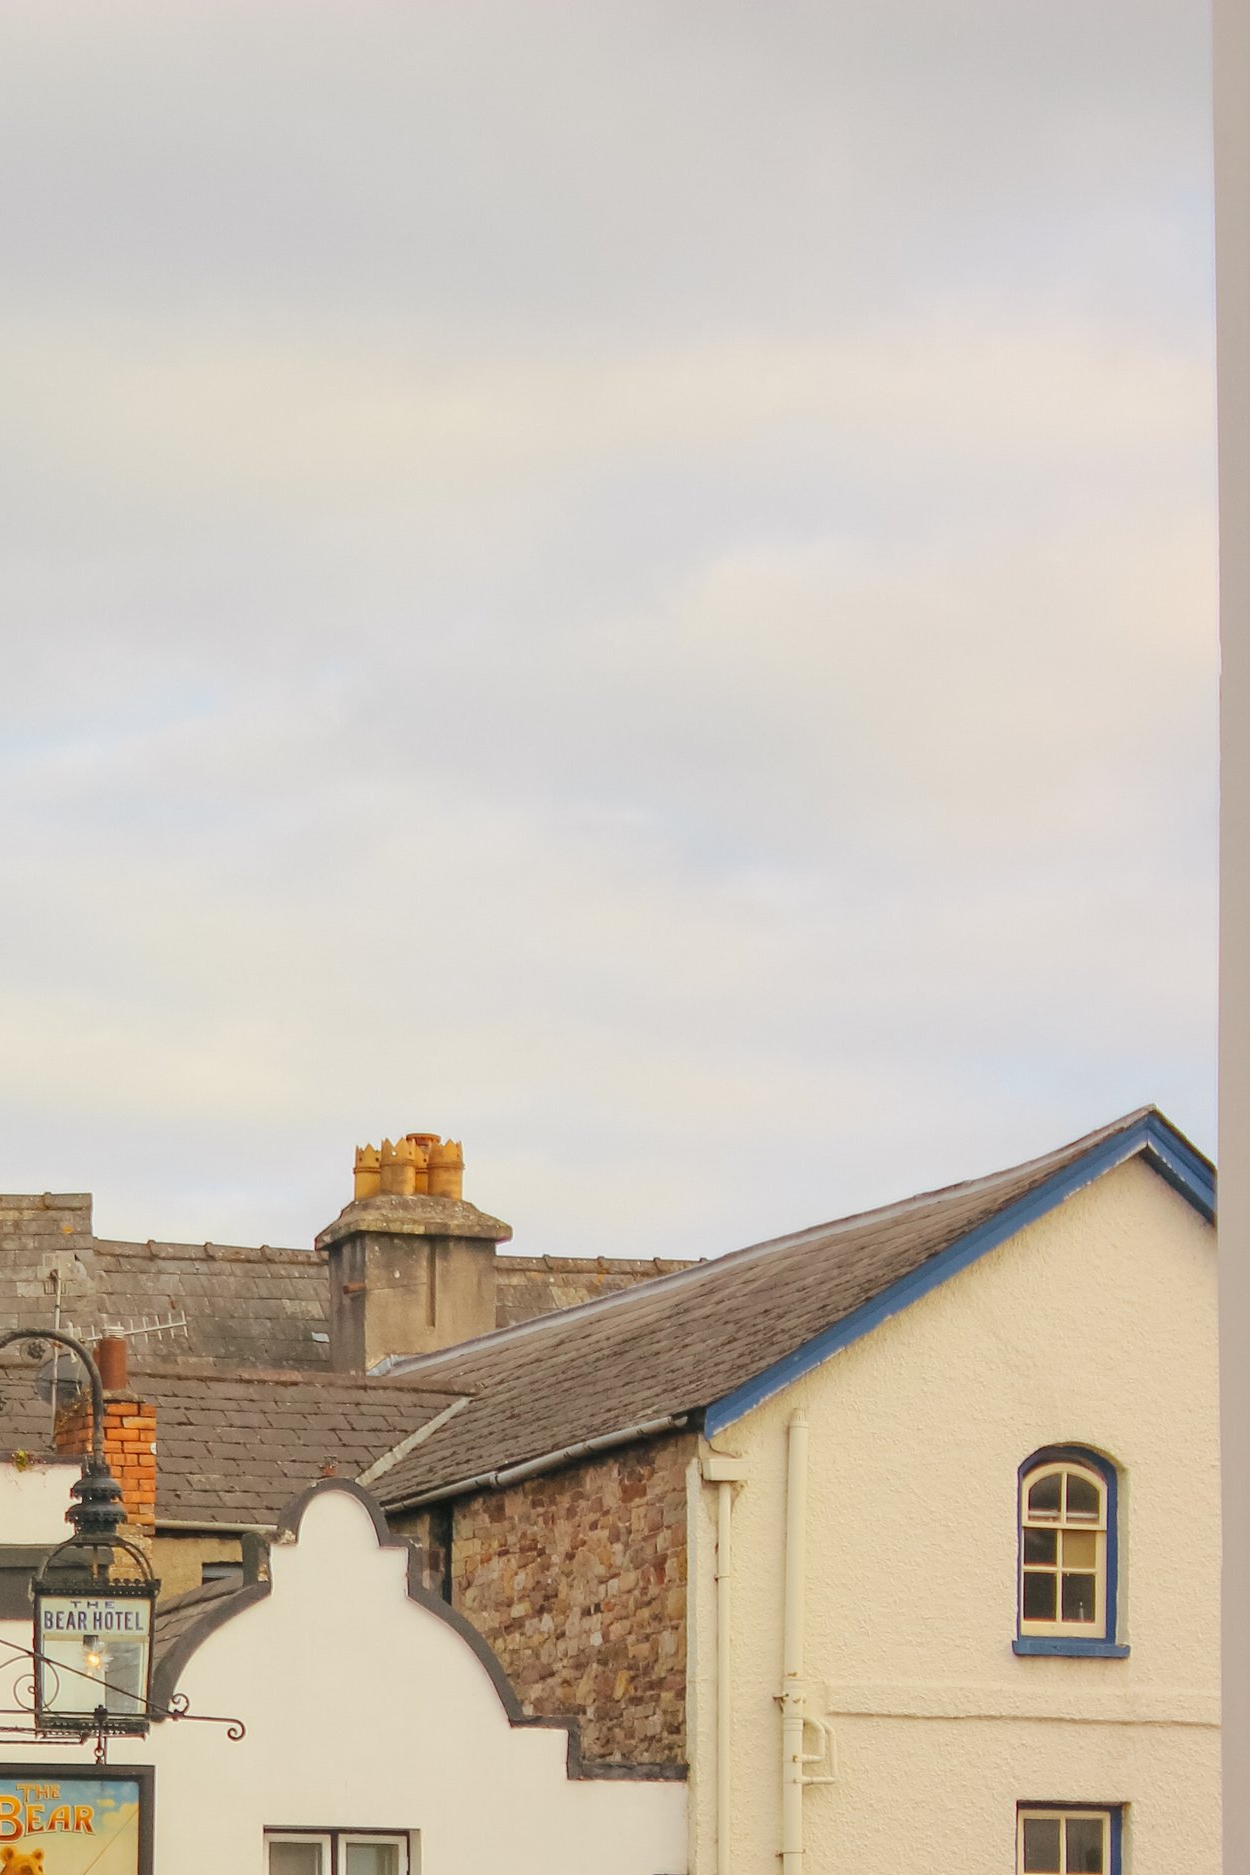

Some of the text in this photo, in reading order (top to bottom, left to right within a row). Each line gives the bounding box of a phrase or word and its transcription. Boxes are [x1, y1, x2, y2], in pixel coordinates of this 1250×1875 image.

[70, 1600, 115, 1609] THE
[43, 1611, 144, 1631] BEAR HOTEL
[15, 1782, 61, 1802] THE
